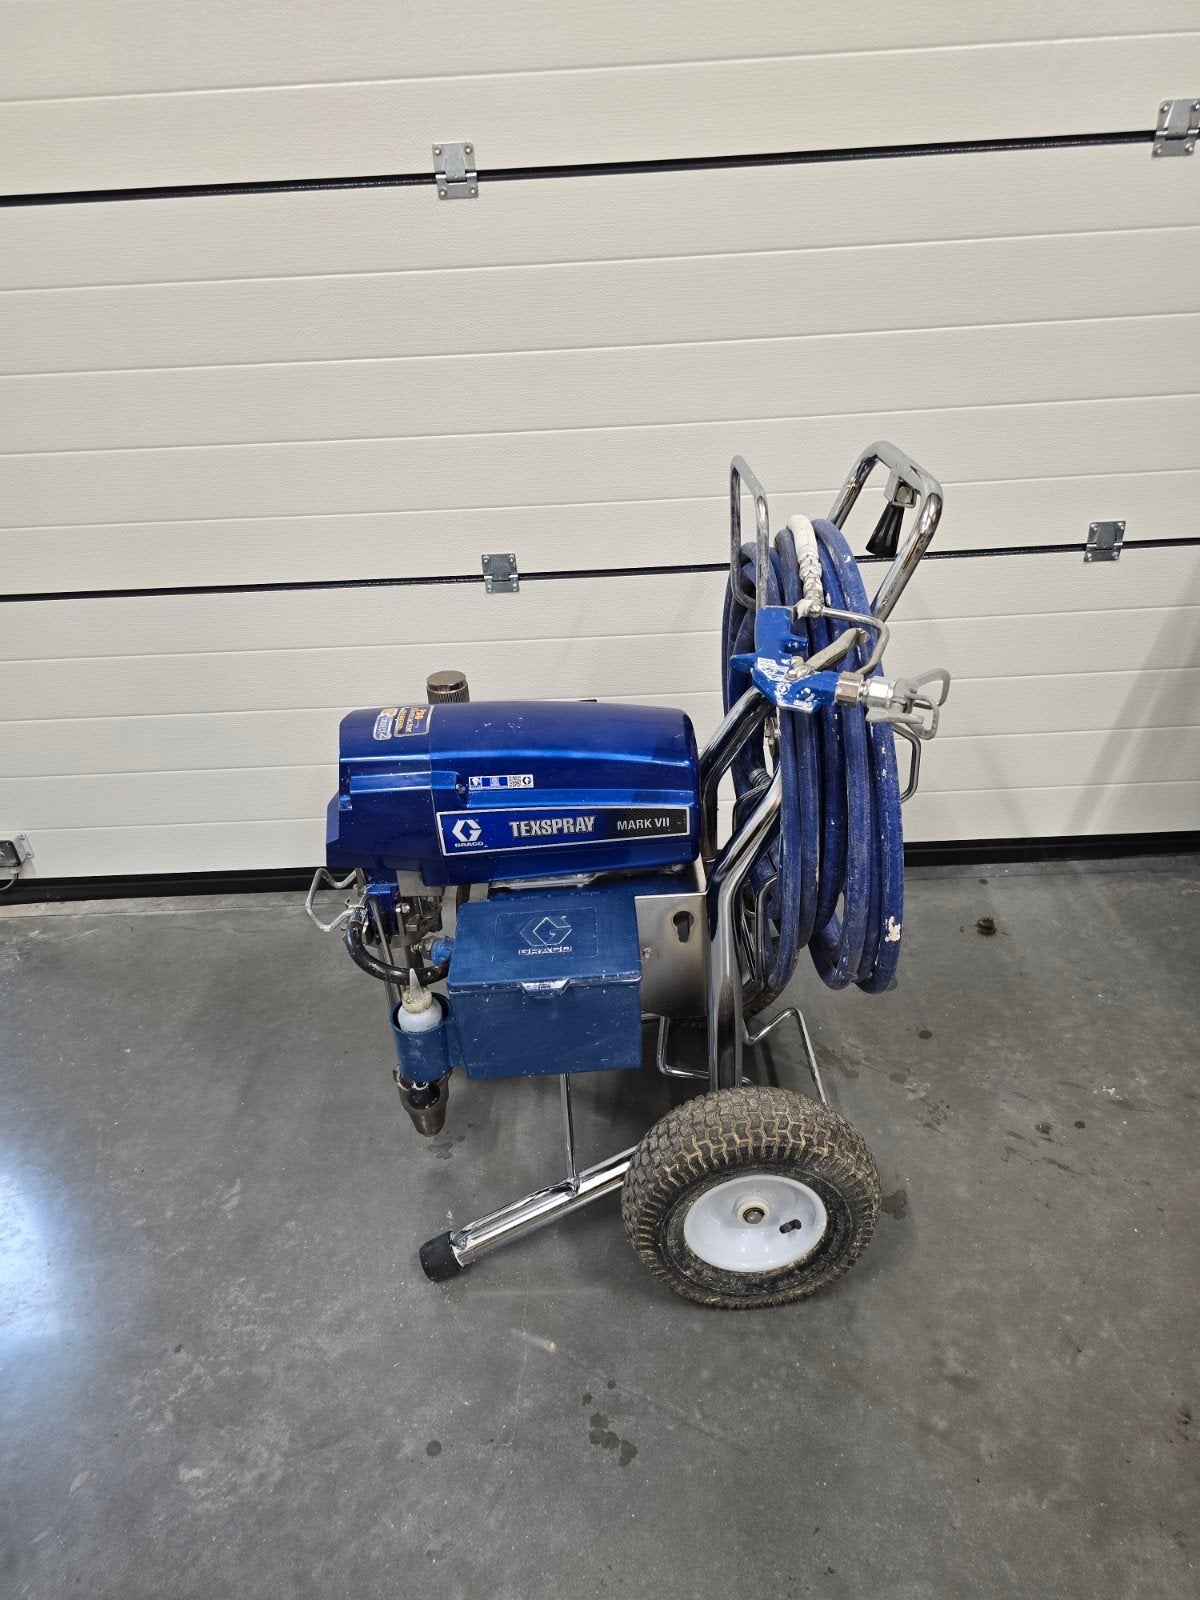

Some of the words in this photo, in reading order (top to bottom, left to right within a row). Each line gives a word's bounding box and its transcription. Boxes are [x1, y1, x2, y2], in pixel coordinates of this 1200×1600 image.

[509, 815, 596, 837] TEXSPRAY
[617, 818, 652, 830] MARK
[654, 817, 670, 828] VII
